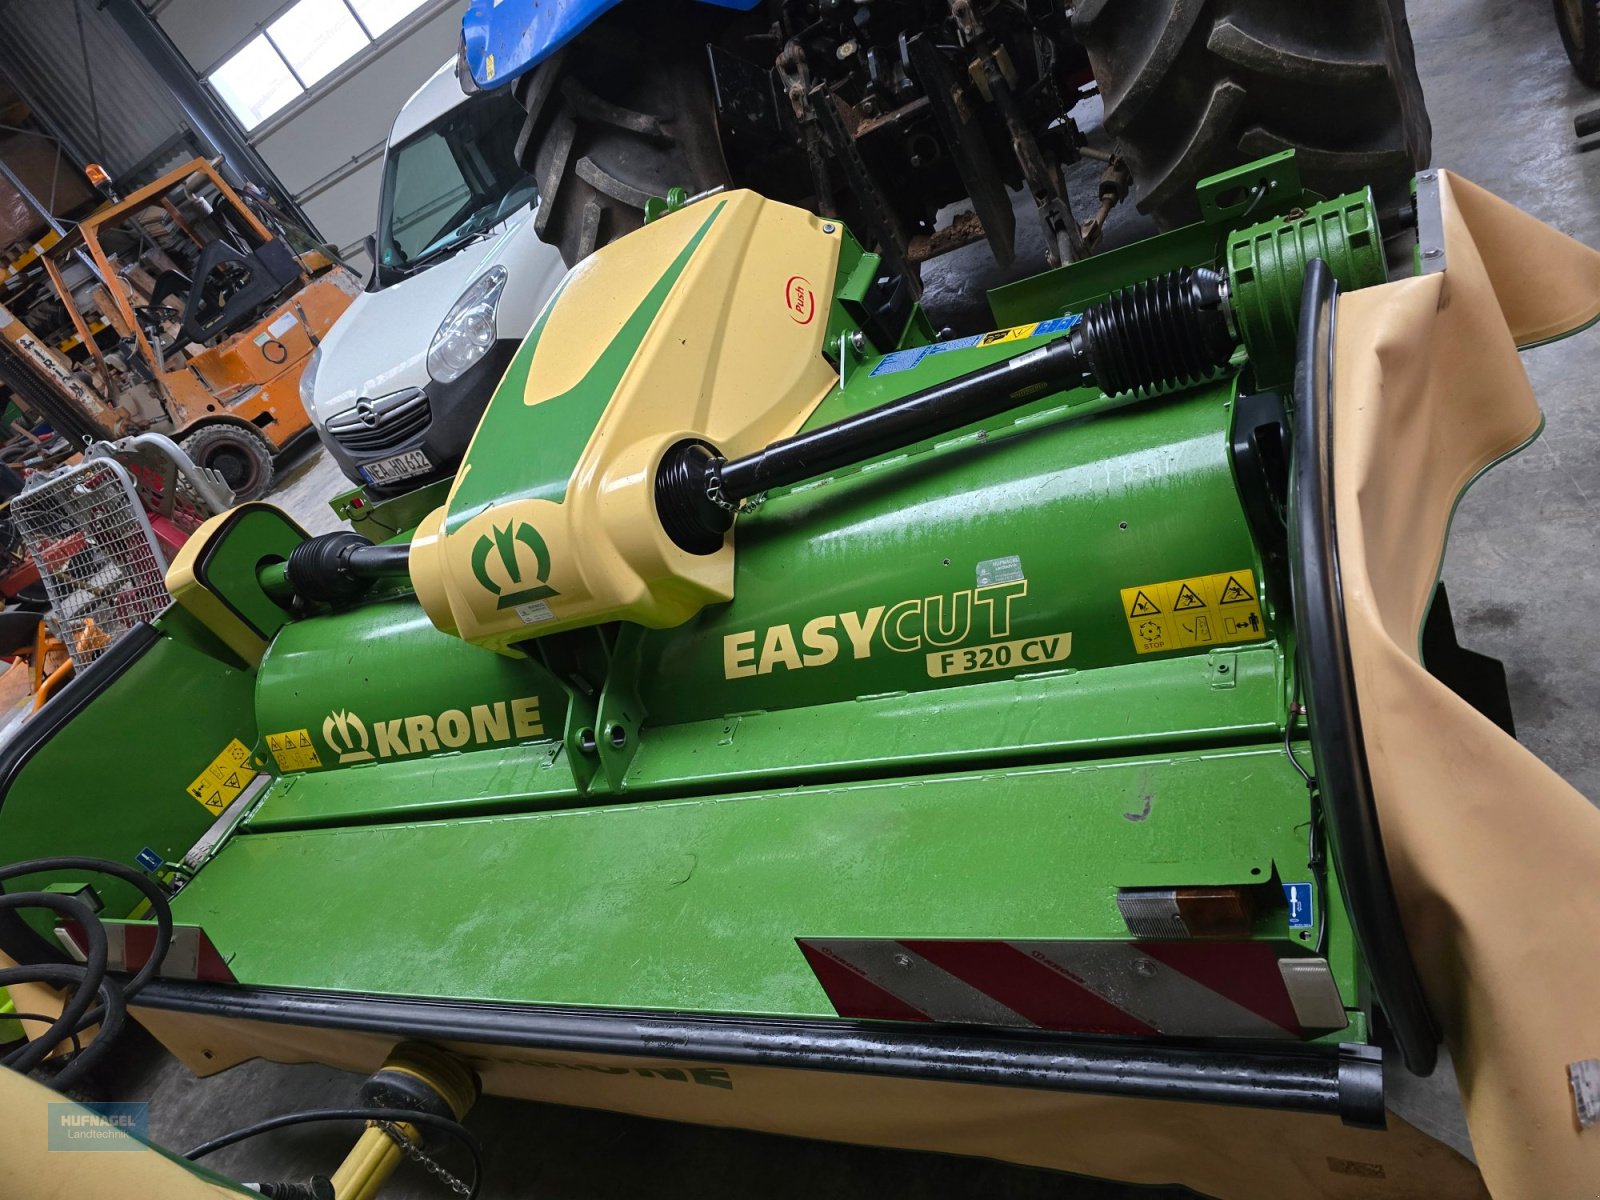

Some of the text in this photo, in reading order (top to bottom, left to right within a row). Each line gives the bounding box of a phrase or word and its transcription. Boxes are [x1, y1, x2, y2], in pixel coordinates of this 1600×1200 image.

[794, 286, 805, 315] Push
[365, 463, 391, 480] NEA
[388, 457, 409, 475] HD
[404, 451, 429, 470] 612
[724, 580, 1028, 680] EASYCUT
[1143, 641, 1164, 650] STOP
[941, 637, 1060, 674] F 320 CV
[373, 696, 544, 758] KRONE
